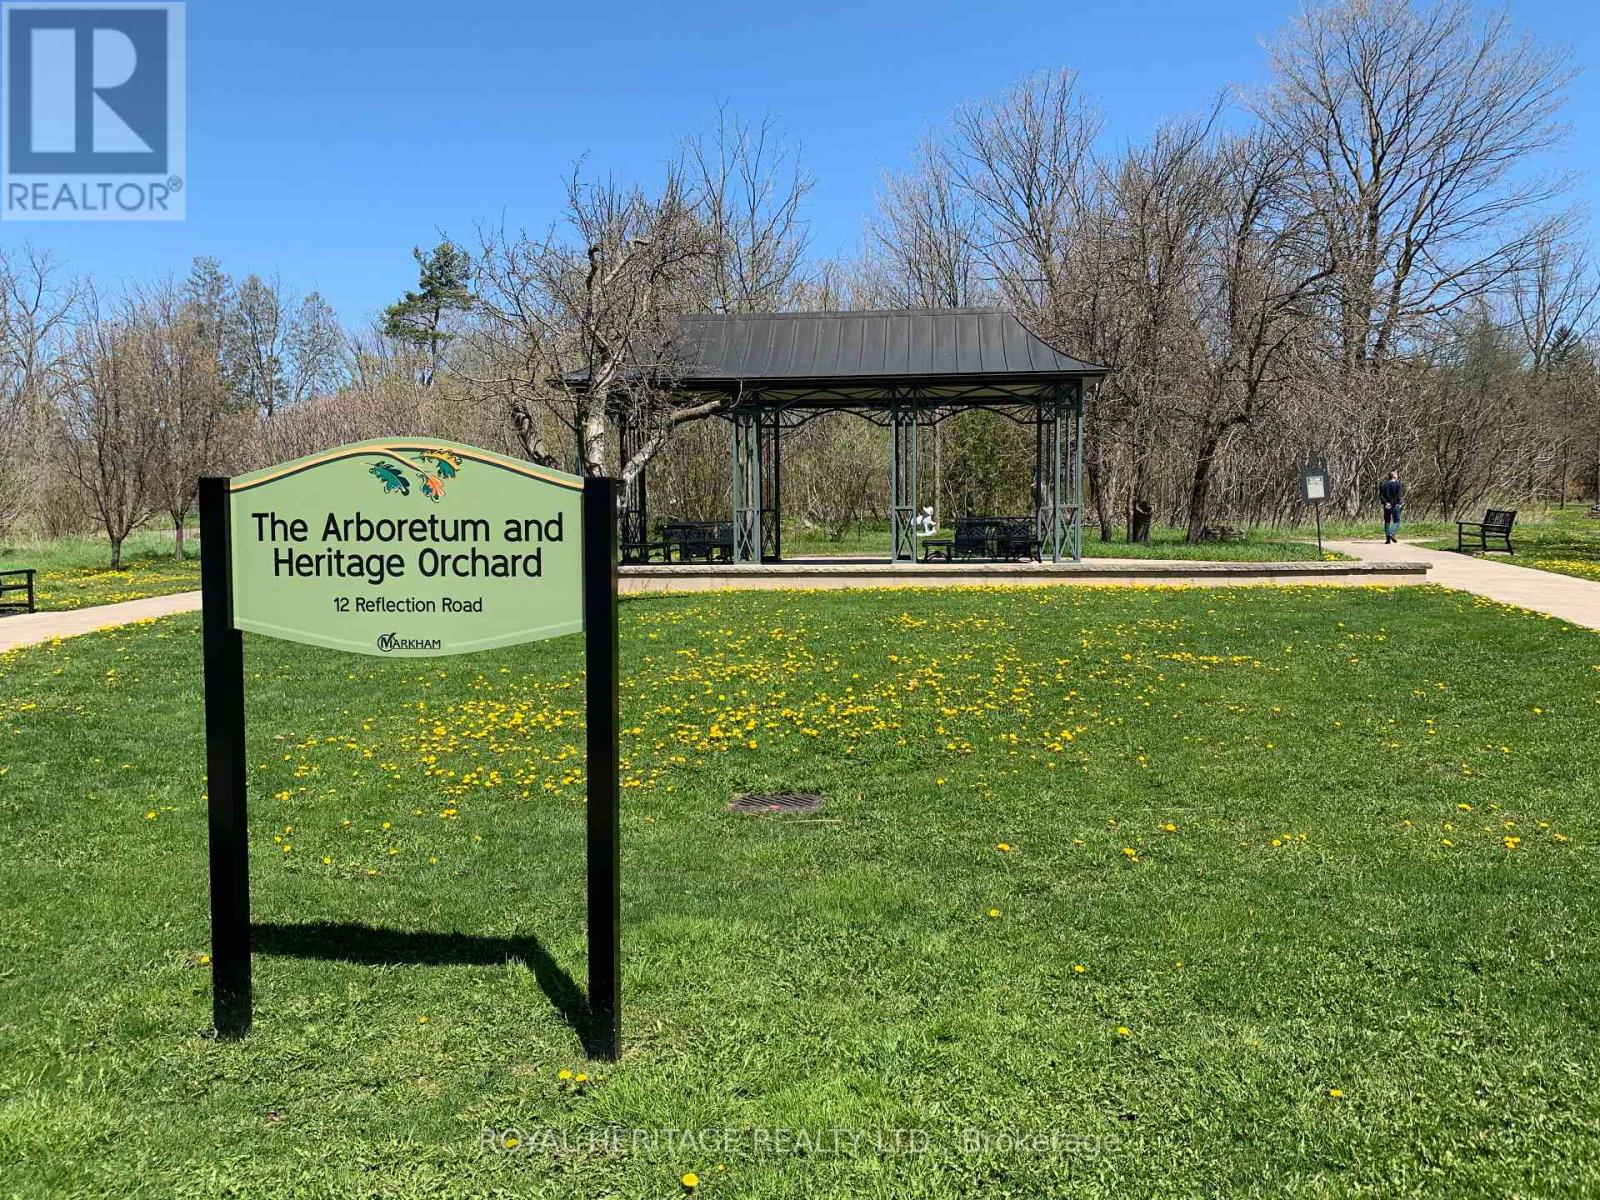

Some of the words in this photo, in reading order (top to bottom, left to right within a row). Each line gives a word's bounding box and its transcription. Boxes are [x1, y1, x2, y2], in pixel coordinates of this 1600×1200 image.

[252, 512, 308, 542] The
[322, 512, 489, 542] Arboretum
[504, 512, 563, 542] and
[274, 547, 405, 585] Heritage
[419, 547, 541, 577] Orchard
[334, 597, 349, 612] 12
[356, 597, 435, 612] Reflection
[442, 597, 482, 612] Road
[377, 633, 440, 652] MARKHAM
